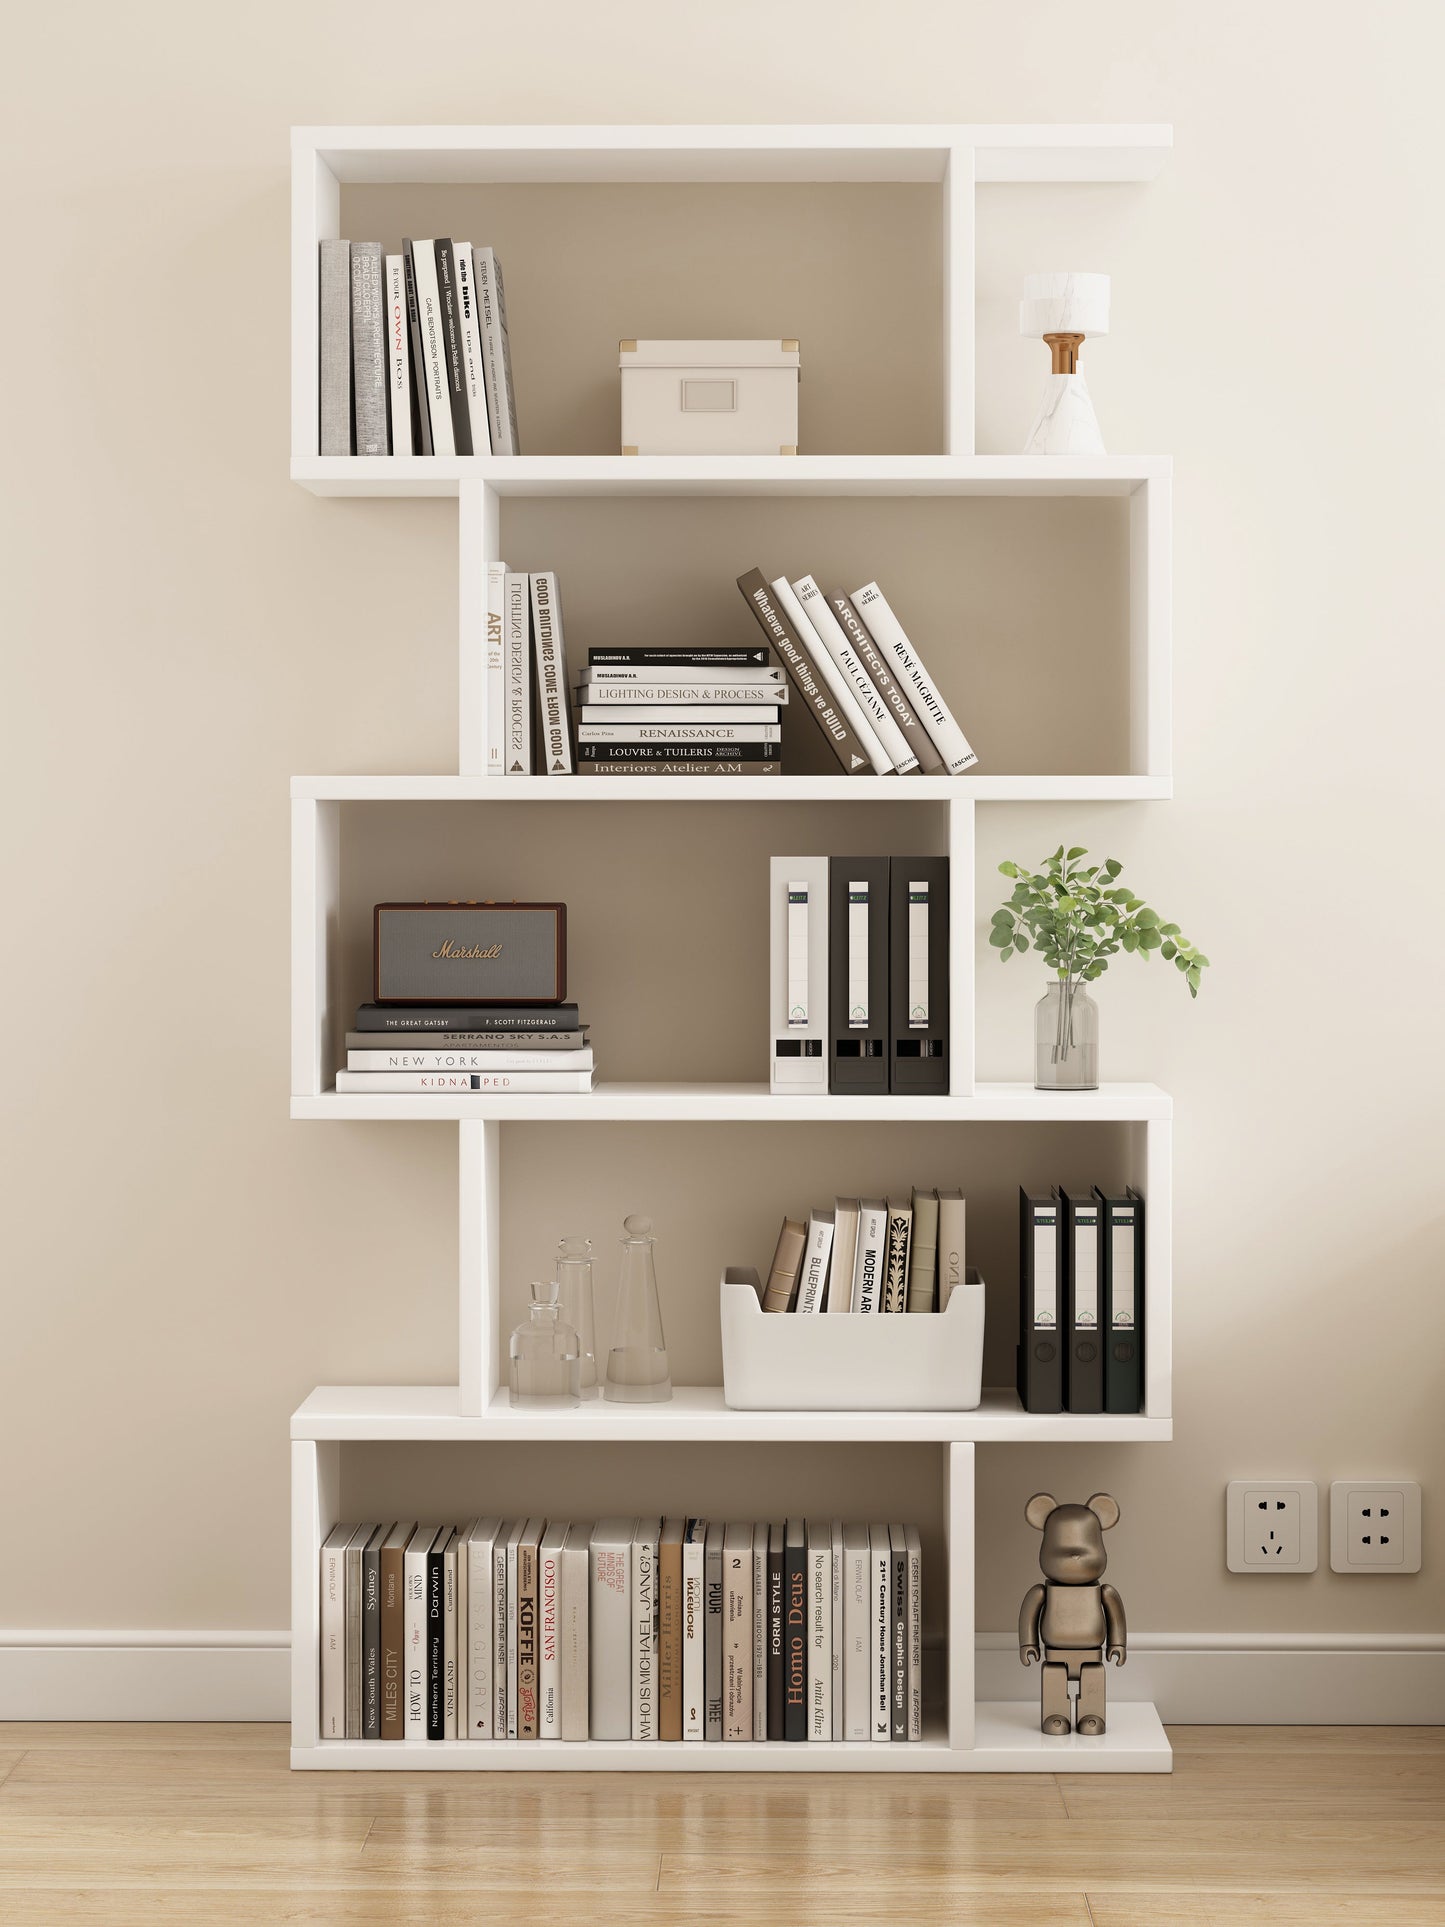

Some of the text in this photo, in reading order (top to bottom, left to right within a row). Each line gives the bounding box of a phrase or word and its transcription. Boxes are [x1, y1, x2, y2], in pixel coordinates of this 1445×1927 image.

[353, 256, 362, 313] OCCUPATION
[362, 256, 370, 280] BRAD
[459, 259, 467, 271] ride
[371, 255, 382, 388] ALLIED WORKS ARCHITECTURE
[462, 286, 471, 319] bike
[483, 289, 493, 329] MEISEL
[394, 305, 402, 351] OWN
[440, 258, 450, 284] prepared
[453, 367, 461, 392] diamond
[427, 316, 437, 359] BENGTSSON
[433, 361, 442, 400] PORTRAITS
[801, 583, 812, 593] ART
[801, 589, 819, 601] SERIES
[861, 592, 880, 606] SERIES
[862, 589, 873, 599] ART
[487, 612, 501, 646] ART
[752, 588, 847, 741] Whatever good things ve BUILD
[834, 599, 917, 728] ARCHITECTS TODAY
[893, 642, 947, 726] RENÉ MAGRITTE
[599, 689, 764, 699] LIGHTING DESIGN & PROCESS
[840, 650, 887, 723] PAUL CÉZANNE
[609, 748, 713, 756] LOUVRE TUILERIS
[639, 729, 735, 738] RENAISSANCE
[594, 763, 742, 772] Interiors Atelier AM
[432, 940, 503, 959] Marshall
[389, 1056, 478, 1066] NEW YORK
[864, 1249, 877, 1294] MODERN
[597, 1552, 606, 1582] FUTURE
[606, 1552, 615, 1588] MINDS OF
[615, 1552, 625, 1594] THE GREAT
[732, 1558, 741, 1569] 2
[832, 1554, 840, 1574] Angoli
[879, 1560, 887, 1582] 21st
[329, 1582, 337, 1601] OLAF
[366, 1567, 377, 1611] Sydney
[413, 1574, 423, 1600] MIND
[431, 1566, 439, 1618] Darwin
[815, 1555, 824, 1649] No search result for
[855, 1559, 863, 1653] ERWIN OLAF AM
[879, 1585, 887, 1624] Century
[520, 1597, 534, 1665] KOFFIE
[772, 1572, 781, 1655] FORM STYLE
[895, 1560, 905, 1709] Swiss Graphic Design
[329, 1638, 336, 1650] AM
[386, 1573, 397, 1721] MILES CITY Montana
[544, 1559, 555, 1724] California SAN FRANCISCO
[640, 1555, 651, 1739] WHO IS MICHAEL JANG?
[662, 1575, 672, 1698] Miller Harris
[708, 1583, 722, 1723] PUUR THEE
[788, 1572, 803, 1705] Homo Deus
[431, 1637, 439, 1680] Territory
[473, 1640, 486, 1710] GLORY
[368, 1647, 376, 1728] New South Wales
[410, 1669, 421, 1721] HOW TO
[519, 1687, 536, 1722] STORIES
[735, 1675, 743, 1704] labiryncie
[814, 1678, 824, 1735] Anita Klinz
